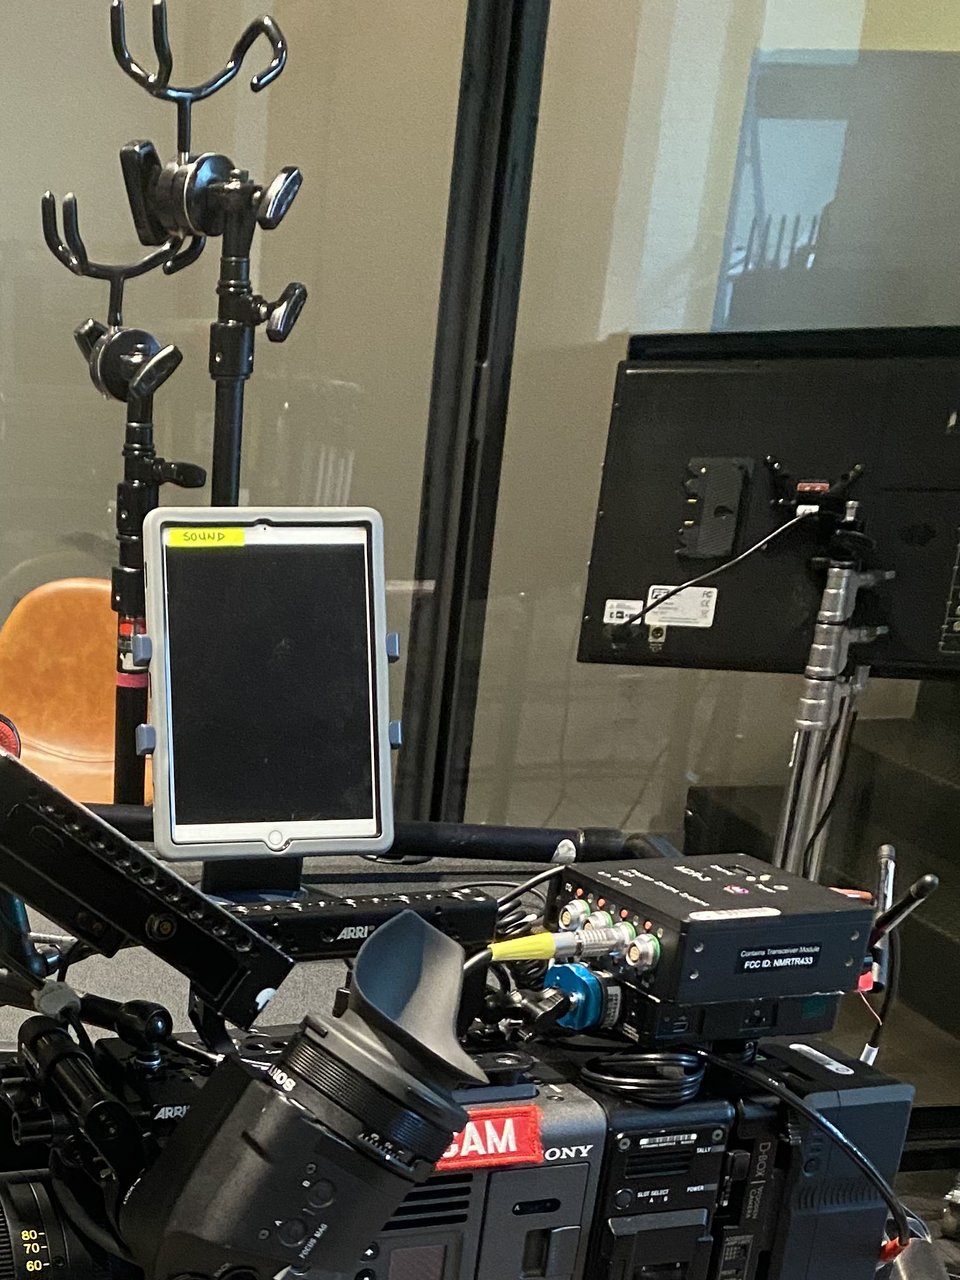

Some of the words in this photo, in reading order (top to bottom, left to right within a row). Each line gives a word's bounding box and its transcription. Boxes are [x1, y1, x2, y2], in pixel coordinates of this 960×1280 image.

[183, 531, 225, 541] SOUND
[336, 925, 369, 940] ARRI
[740, 950, 766, 958] Contains
[767, 947, 798, 955] Transceiver
[799, 945, 820, 953] Module
[744, 960, 761, 969] FCC
[773, 956, 814, 967] NMRTR433
[153, 1105, 187, 1120] ARRI
[543, 1144, 594, 1161] ONY
[696, 1146, 712, 1154] TALLY
[754, 1142, 772, 1178] D-BOX
[637, 1190, 650, 1198] SLOT
[650, 1188, 669, 1196] SELECT
[21, 1229, 38, 1240] 80
[298, 1238, 317, 1260] FOCUS
[313, 1223, 328, 1239] MAG
[23, 1243, 40, 1254] 70
[26, 1260, 42, 1271] 60
